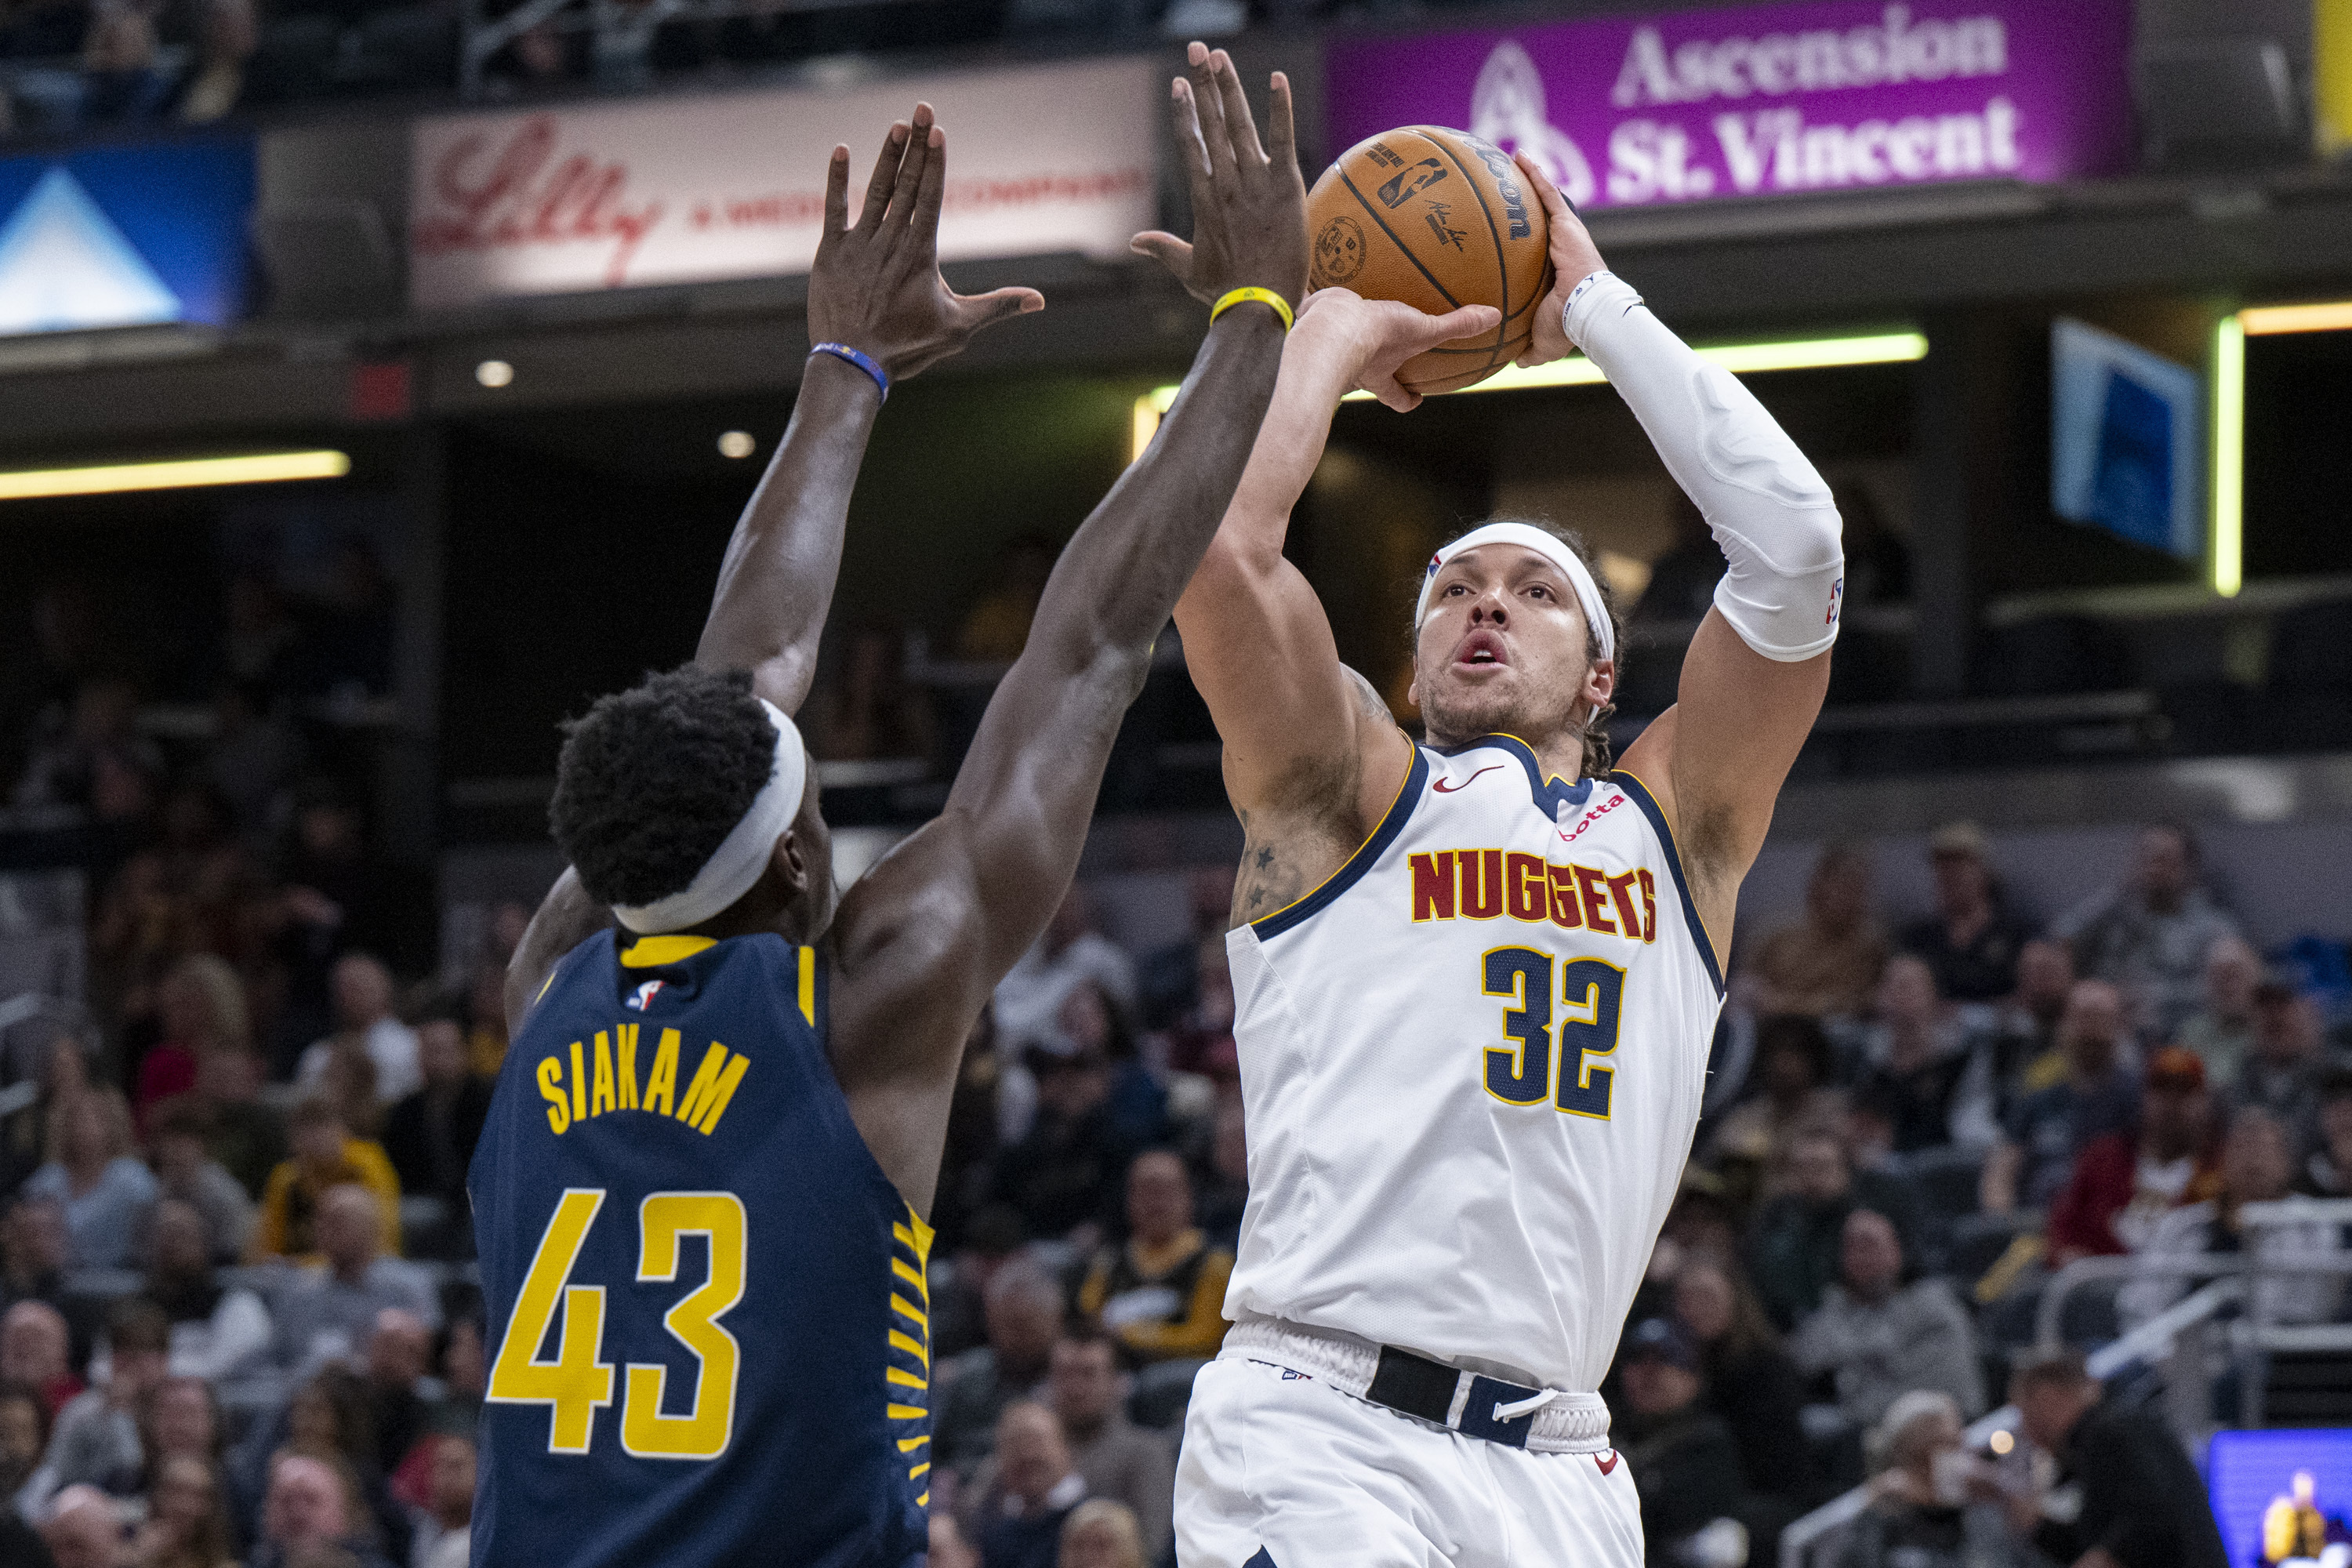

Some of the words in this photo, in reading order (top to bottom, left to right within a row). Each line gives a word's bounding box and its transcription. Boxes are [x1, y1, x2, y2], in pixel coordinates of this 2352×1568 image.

[1613, 6, 2008, 107] Ascension
[413, 112, 663, 287] Lilly
[1607, 119, 1715, 204] St.
[1713, 97, 2024, 194] Vincent
[1408, 848, 1657, 945] NUGGETS
[536, 1022, 751, 1136] SIAKAM
[1481, 944, 1628, 1122] 32
[485, 1188, 748, 1461] 43
